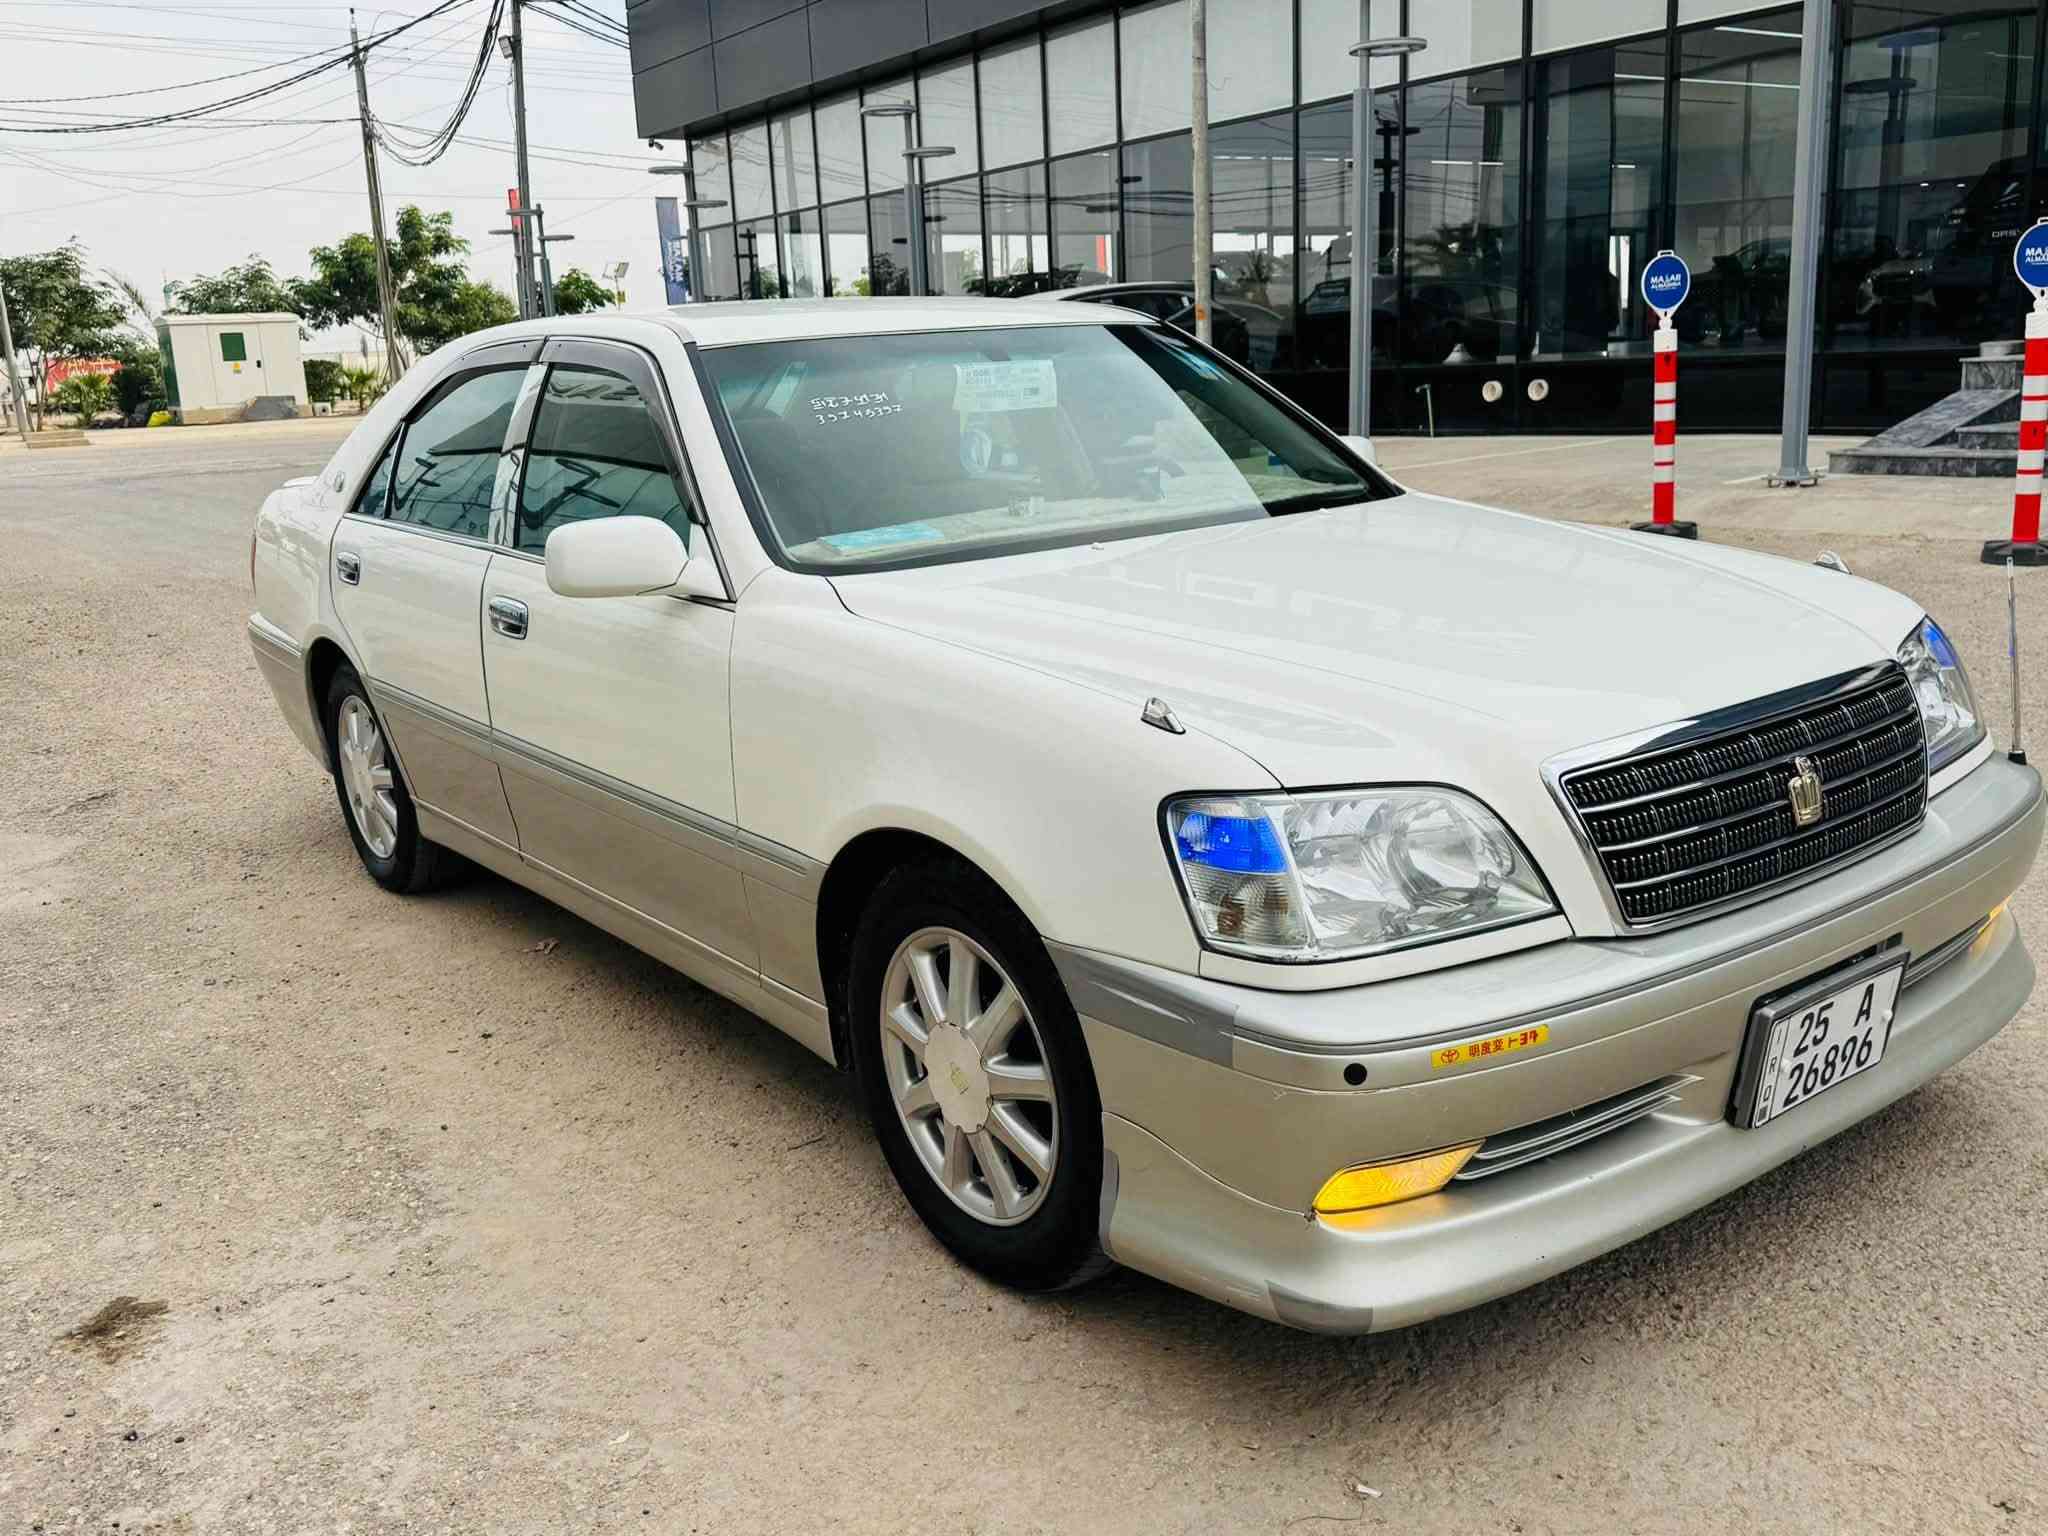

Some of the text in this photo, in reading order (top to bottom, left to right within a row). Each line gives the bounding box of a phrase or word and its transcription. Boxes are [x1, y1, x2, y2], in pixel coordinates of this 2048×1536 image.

[1793, 982, 1875, 1058] 25 A
[1782, 1026, 1873, 1108] 26896
